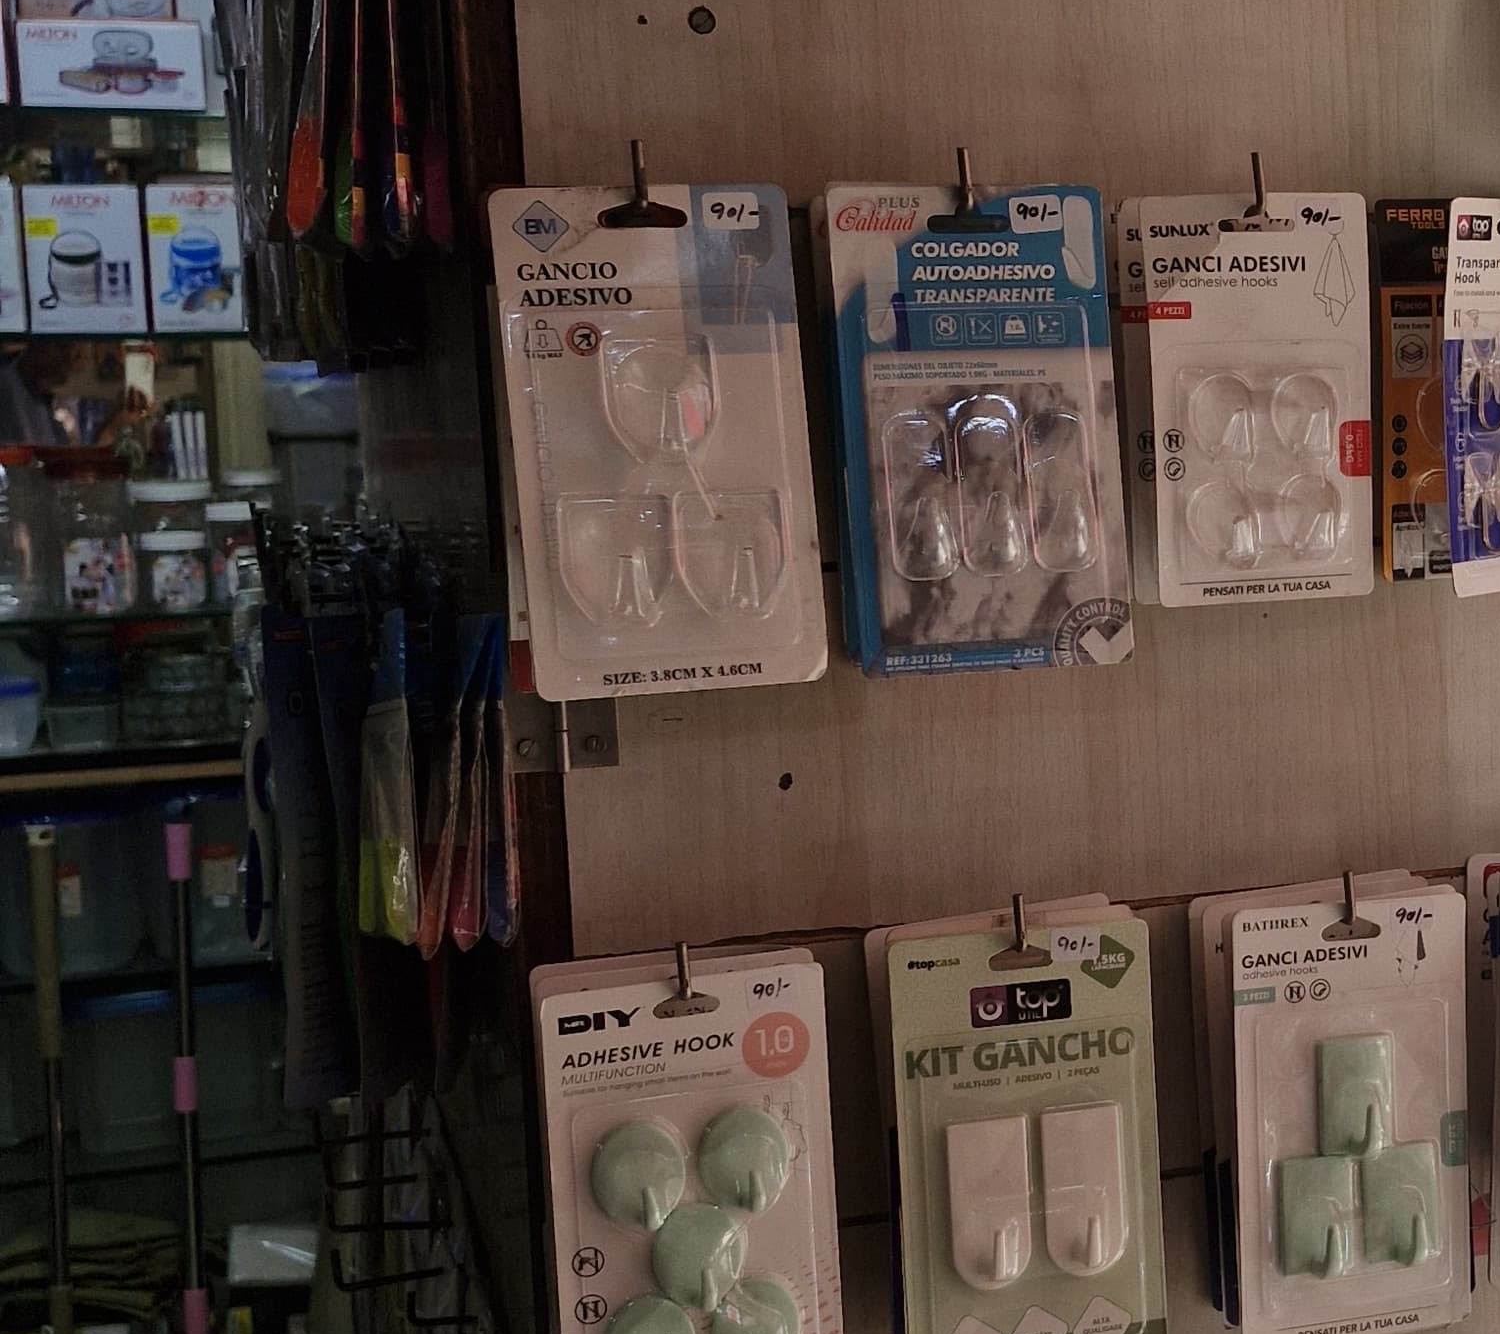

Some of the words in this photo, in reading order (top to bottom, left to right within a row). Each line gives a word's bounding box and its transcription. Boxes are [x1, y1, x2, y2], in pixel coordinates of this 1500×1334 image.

[50, 194, 111, 209] MILTON
[878, 197, 921, 209] PLUS
[710, 201, 759, 224] 90/-
[1016, 203, 1059, 221] 90/-
[1300, 207, 1341, 226] 90/-
[1385, 208, 1445, 221] FERRO
[1148, 223, 1210, 238] SUNLUX
[911, 241, 1020, 258] COLGADOR
[517, 261, 618, 282] GANCIO
[911, 264, 1056, 282] AUTOADHESIVO
[1152, 256, 1222, 274] GANCI
[1229, 255, 1306, 272] ADESIVI
[1152, 275, 1176, 289] self
[1178, 276, 1238, 288] adhesive
[1241, 275, 1278, 288] hooks
[1453, 271, 1481, 285] Hook
[520, 287, 632, 307] ADESIVO
[914, 287, 1056, 304] TRANSPARENTE
[1202, 585, 1245, 597] PENSATI
[1246, 584, 1265, 594] PER
[1268, 583, 1280, 593] LA
[1282, 581, 1302, 592] TUA
[1305, 580, 1331, 590] CASA
[603, 671, 647, 685] SIZE:
[650, 668, 697, 682] 3.8CM
[716, 662, 763, 677] 4.6CM
[1242, 917, 1309, 932] BATHREX
[1395, 907, 1433, 924] 90/-
[1057, 936, 1094, 954] 90/-
[1241, 951, 1298, 969] GANCI
[1303, 945, 1368, 963] ADESIVI
[1242, 968, 1288, 981] adhesive
[1290, 965, 1318, 976] hooks
[753, 977, 791, 999] 90/-
[1015, 986, 1061, 1018] top
[558, 1006, 640, 1035] DIY
[754, 1025, 795, 1057] 1.0
[561, 1042, 664, 1070] ADHESIVE
[673, 1032, 735, 1055] HOOK
[905, 1045, 964, 1079] KIT
[972, 1026, 1136, 1072] GANCHO
[561, 1063, 666, 1086] MULTIFUNCTION
[1015, 1071, 1052, 1084] ADESIVO
[1339, 1323, 1358, 1334] PER
[1359, 1322, 1372, 1332] LA
[1374, 1318, 1393, 1330] TUA
[1395, 1314, 1420, 1326] CASA
